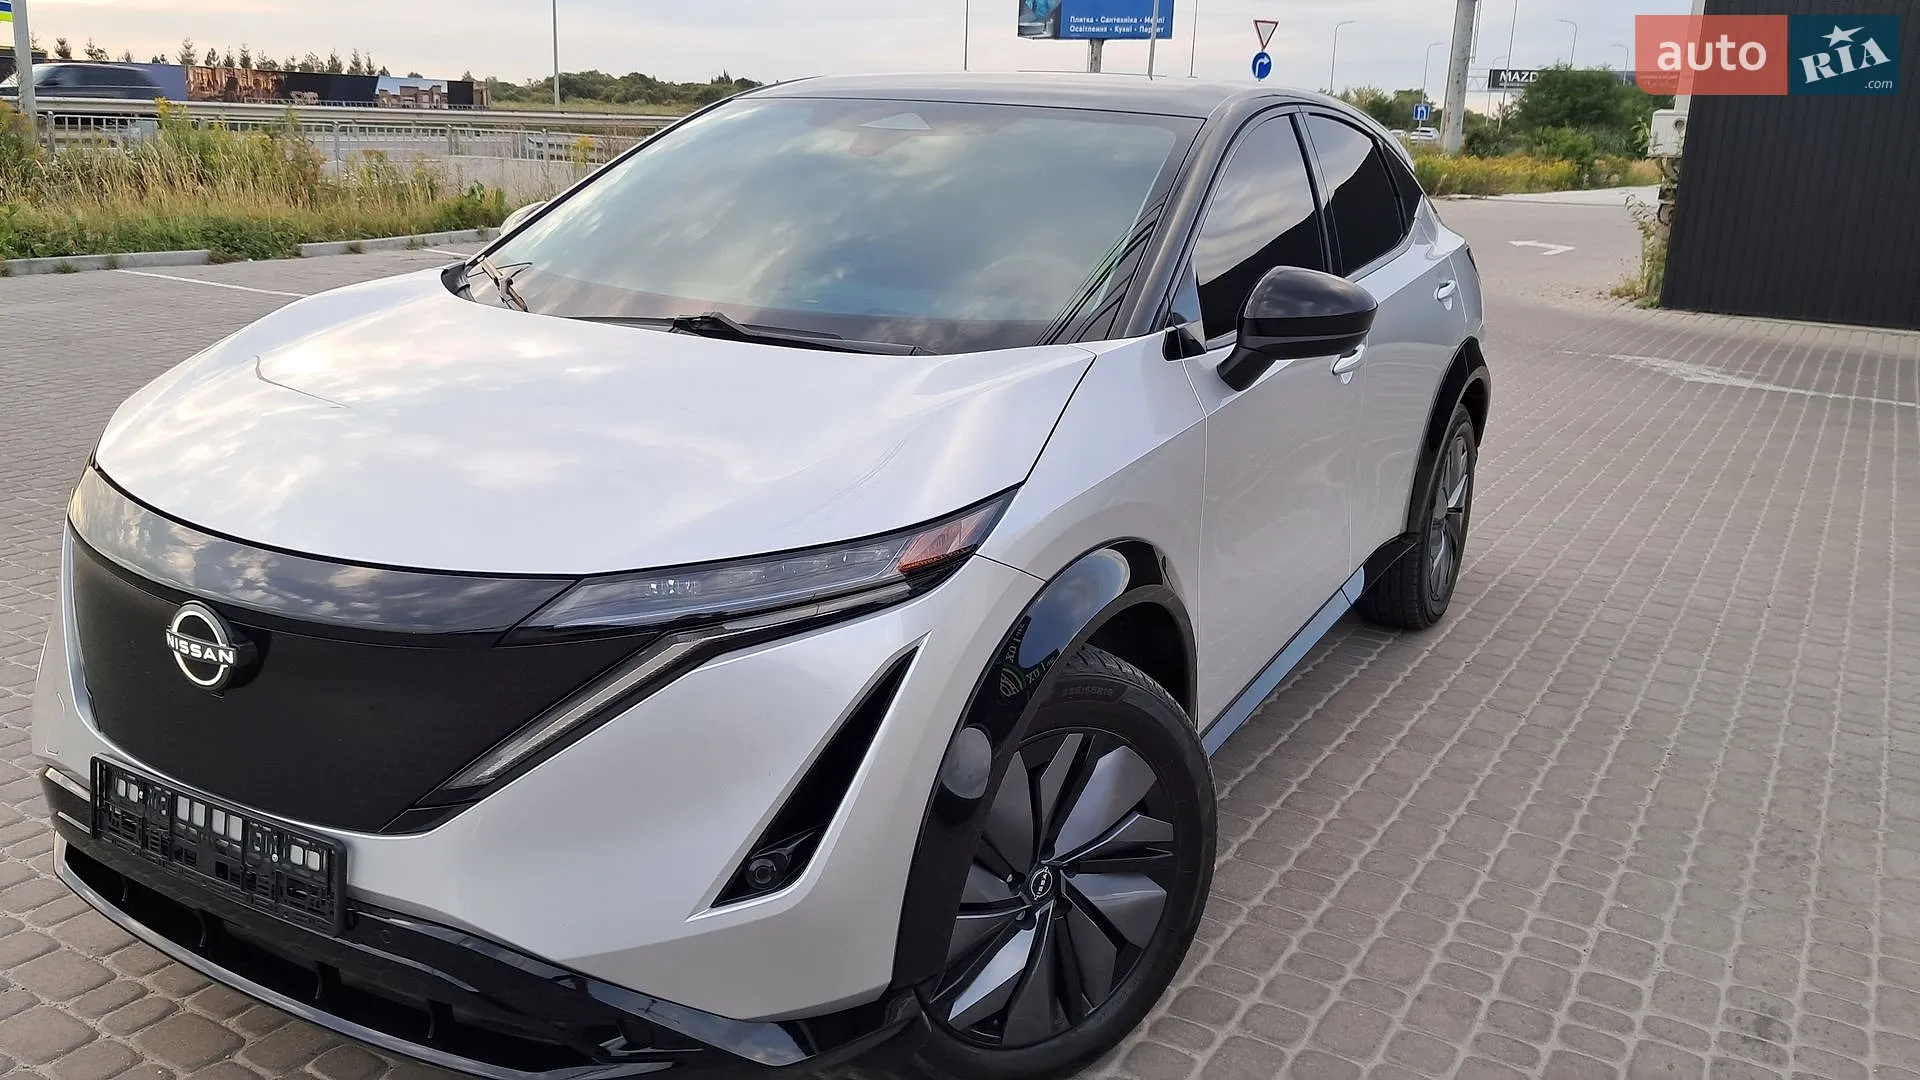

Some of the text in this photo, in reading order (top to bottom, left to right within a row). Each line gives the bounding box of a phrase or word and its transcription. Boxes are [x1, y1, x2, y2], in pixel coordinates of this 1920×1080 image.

[1100, 16, 1138, 24] Сантехніка
[1070, 25, 1164, 34] Освітлення Кухні Парет
[1499, 71, 1539, 83] MAZD
[166, 632, 234, 664] NISSAN
